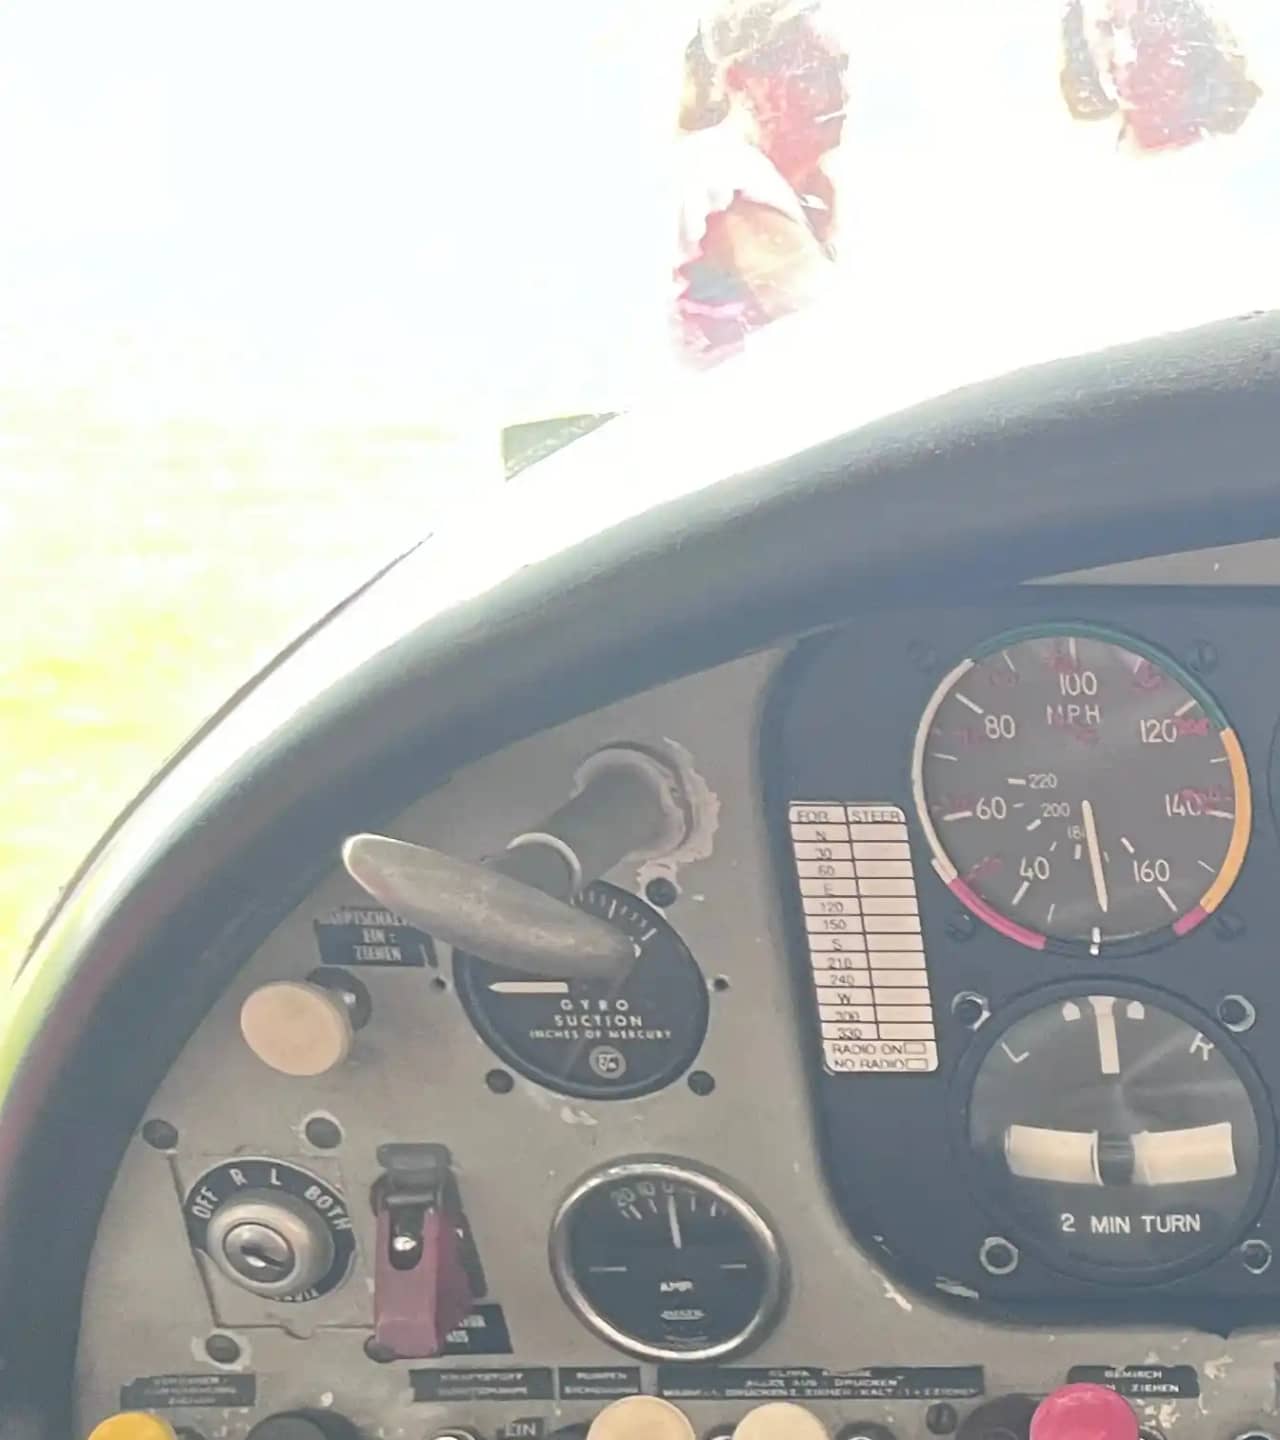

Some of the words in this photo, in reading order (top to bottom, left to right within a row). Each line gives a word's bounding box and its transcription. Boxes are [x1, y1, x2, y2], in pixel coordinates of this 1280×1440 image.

[1059, 671, 1097, 696] 100
[984, 715, 1015, 739] 80
[1139, 719, 1177, 743] 120
[1028, 774, 1057, 789] 220
[976, 796, 1006, 820] 60
[1040, 802, 1070, 817] 200
[1165, 793, 1201, 817] 140
[1019, 857, 1050, 880] 40
[1133, 859, 1170, 883] 160
[560, 999, 628, 1011] GYRO
[554, 1015, 642, 1027] SUCTION
[529, 1029, 579, 1039] INCHES
[609, 1030, 672, 1039] MERCURY
[832, 1043, 877, 1056] RADIO
[229, 1168, 248, 1185] R
[270, 1168, 282, 1185] L
[192, 1185, 219, 1220] OFF
[304, 1185, 352, 1230] BOTH
[1060, 1213, 1076, 1233] 2
[1090, 1215, 1131, 1234] MIN
[1141, 1214, 1201, 1233] TURN
[1130, 1384, 1179, 1393] ZIEHEN
